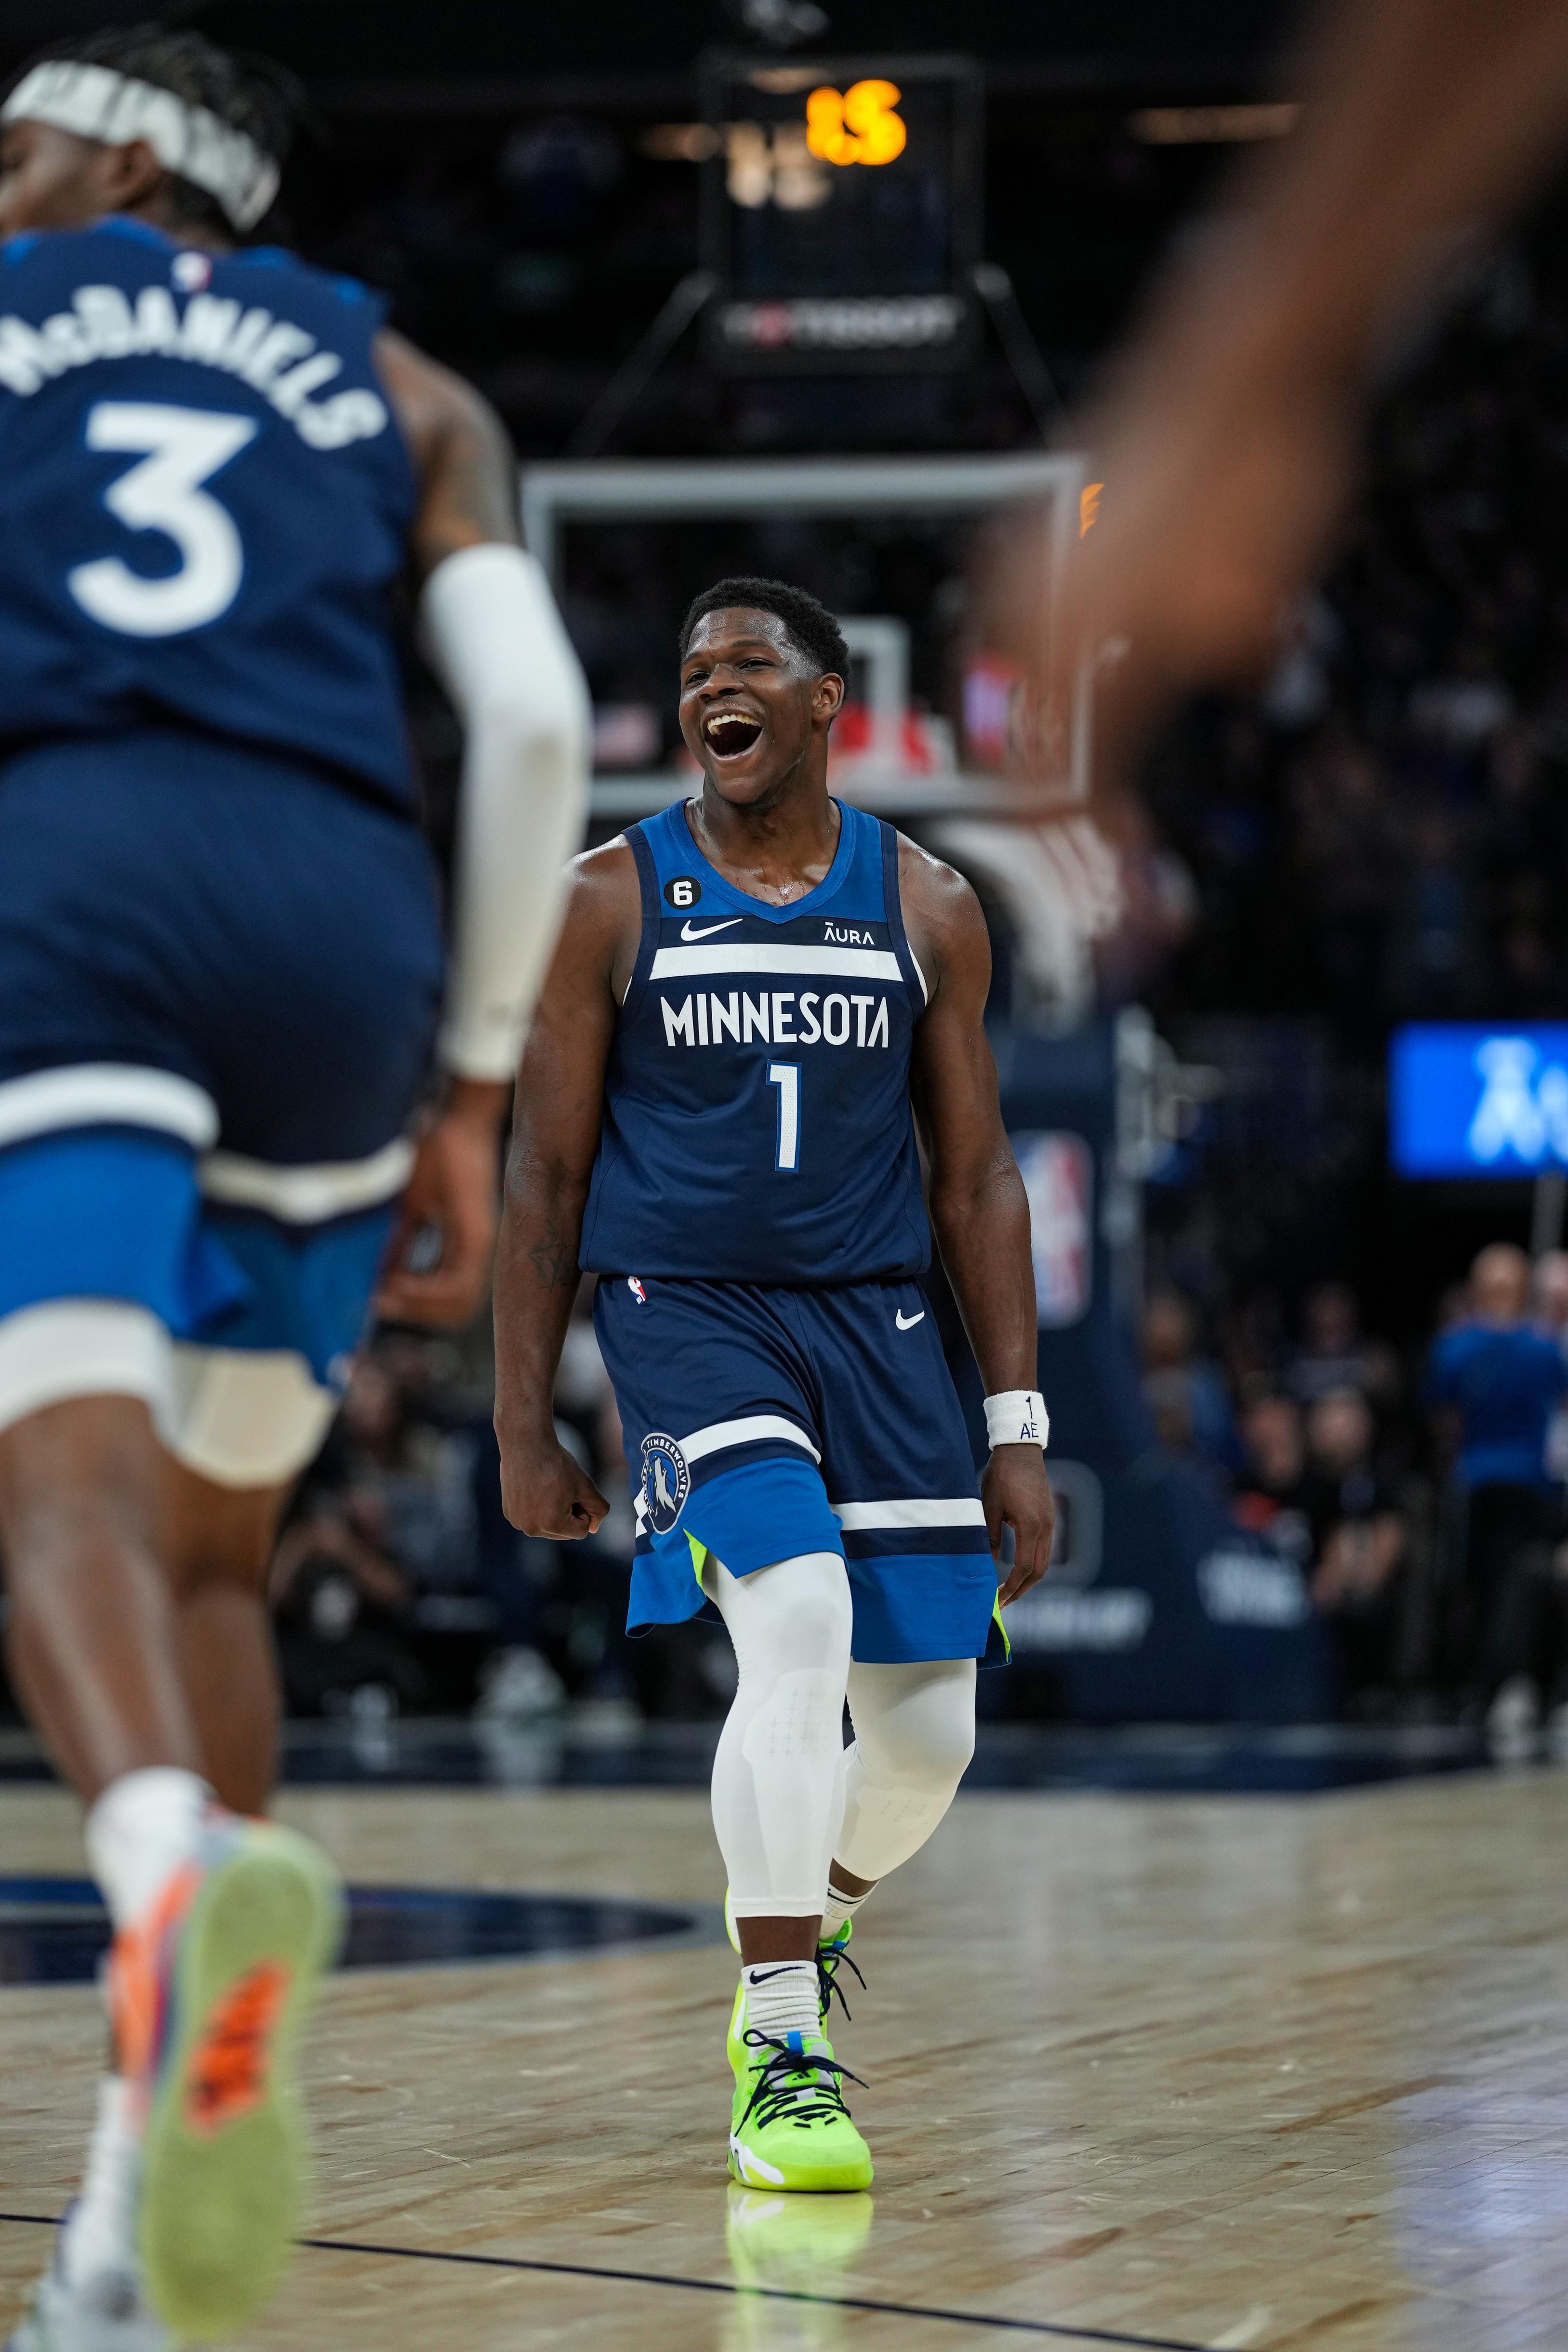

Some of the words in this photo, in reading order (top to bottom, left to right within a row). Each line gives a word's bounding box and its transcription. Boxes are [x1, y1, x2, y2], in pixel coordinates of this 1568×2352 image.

[66, 401, 258, 637] 3
[673, 881, 692, 905] 6
[661, 992, 888, 1048] MINNESOTA
[766, 1059, 802, 1173] 1
[1020, 1422, 1039, 1440] AE
[1025, 1396, 1033, 1420] 1
[646, 1438, 687, 1499] TIMBERWOLVES
